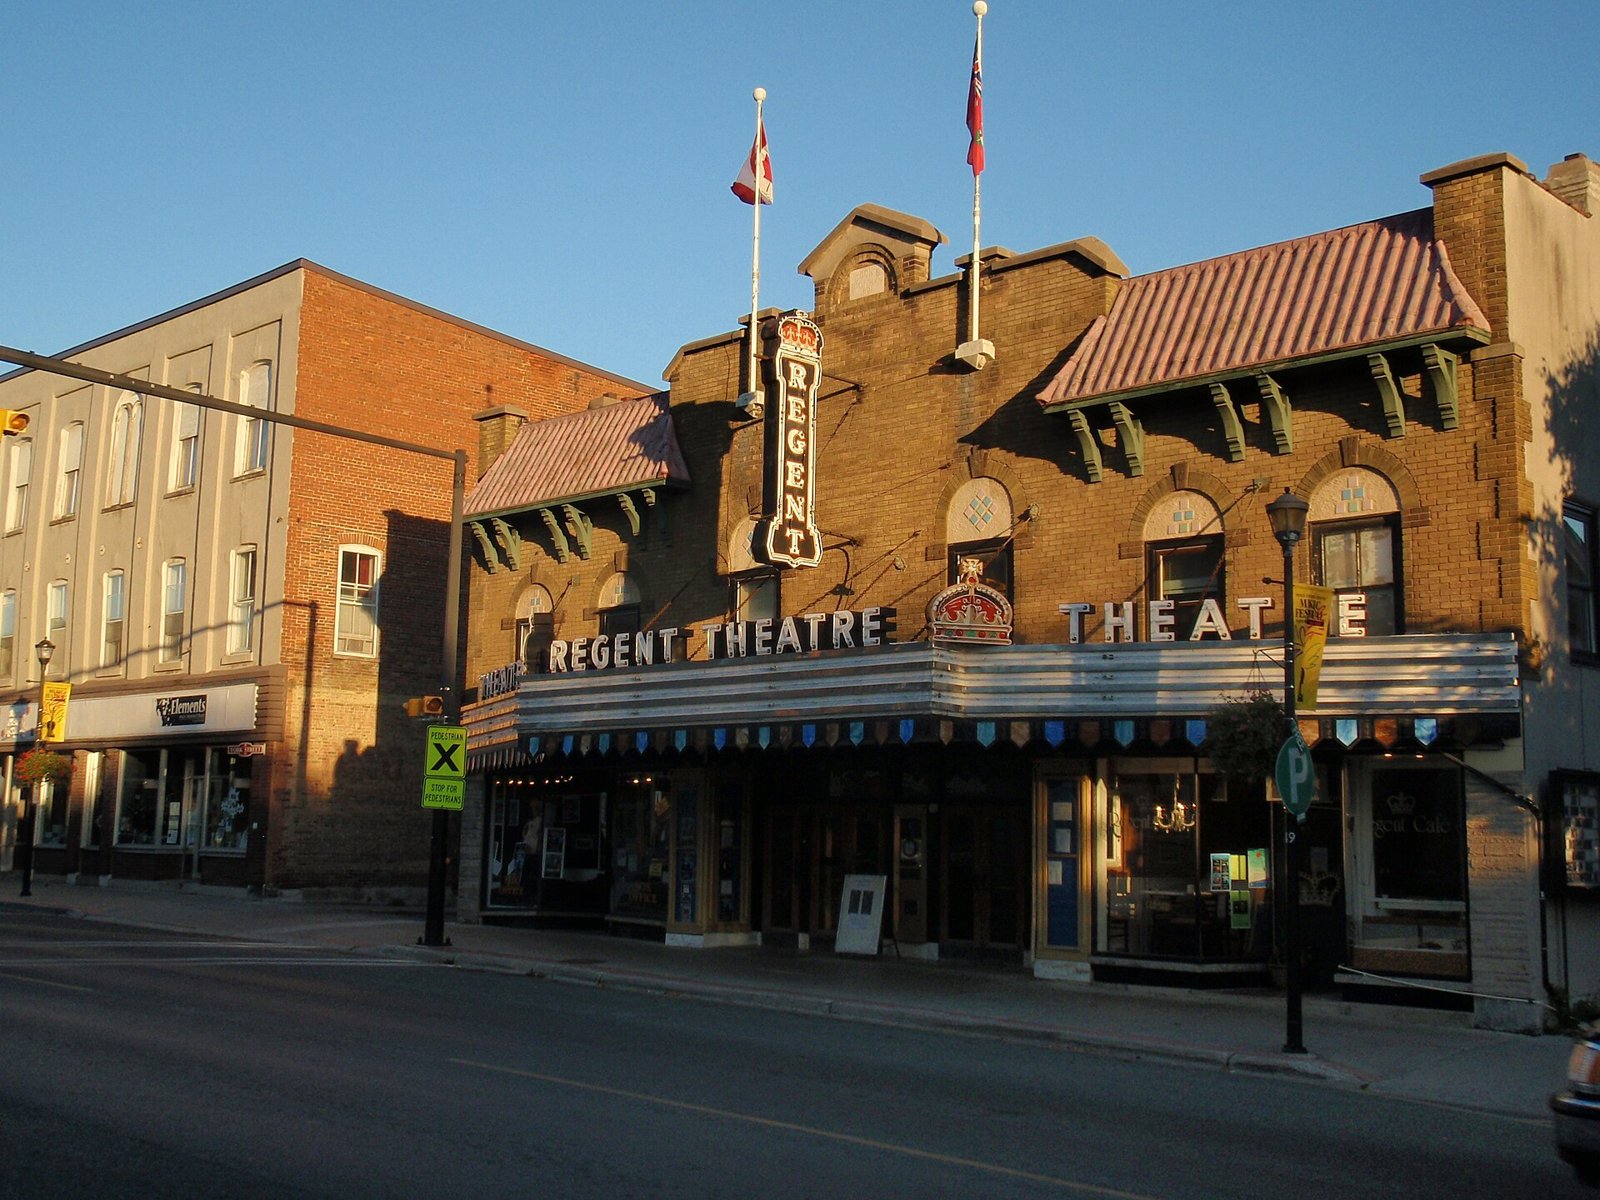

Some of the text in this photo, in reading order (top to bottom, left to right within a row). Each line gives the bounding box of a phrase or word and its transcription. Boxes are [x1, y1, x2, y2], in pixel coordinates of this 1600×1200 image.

[786, 361, 807, 556] REGENT
[1058, 592, 1368, 644] THEATE
[549, 607, 882, 674] REGENT THEATRE
[170, 697, 206, 716] Elements
[430, 731, 464, 742] PEDESTRIAN
[430, 742, 461, 772] X
[431, 783, 458, 794] STOP FOR
[1288, 746, 1309, 804] P
[424, 793, 461, 804] PEDESTRIANS
